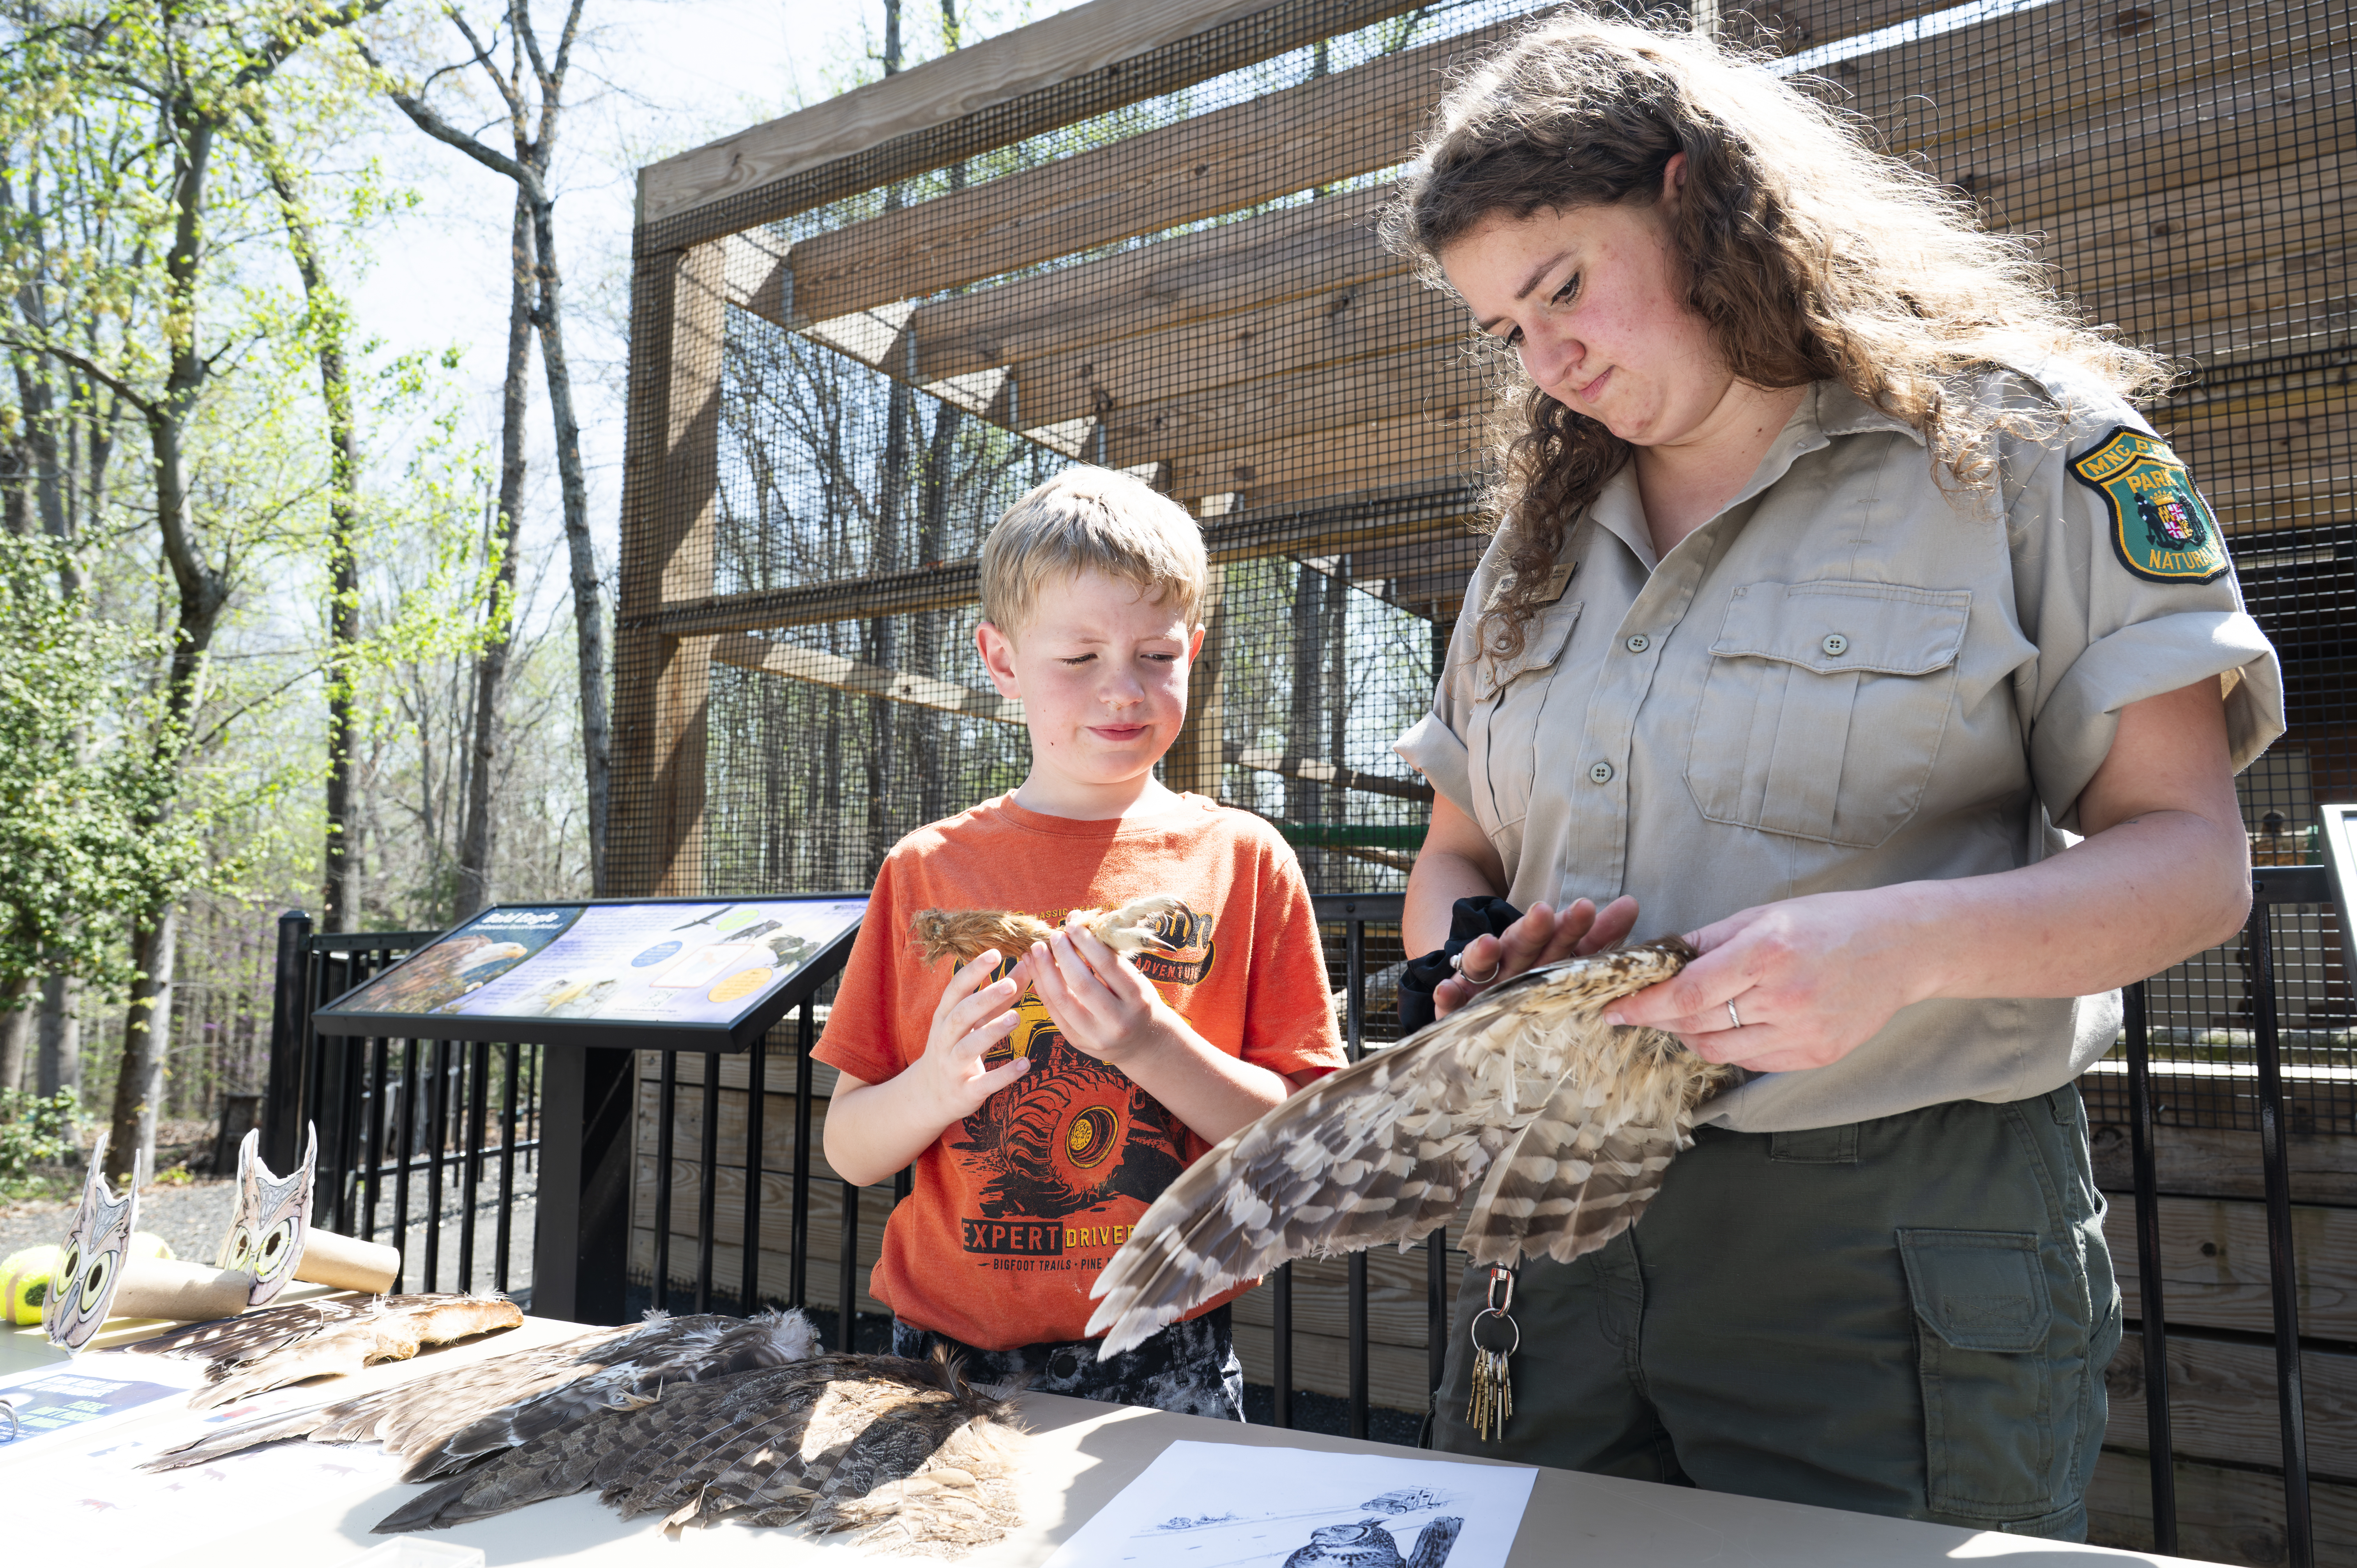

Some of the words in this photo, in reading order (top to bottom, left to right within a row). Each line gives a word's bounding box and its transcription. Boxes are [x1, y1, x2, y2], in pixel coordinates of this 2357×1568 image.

[2086, 444, 2130, 475] MNC
[2125, 468, 2178, 494] PARK
[963, 1222, 1059, 1250] EXPERT
[994, 1259, 1035, 1271] BIGFOOT
[1039, 1259, 1071, 1271] TRAILS
[1081, 1258, 1102, 1270] PINE
[19, 1382, 54, 1390] EAT
[72, 1379, 107, 1387] YEAR
[27, 1406, 70, 1417] DON'T
[54, 1410, 104, 1422] POISON
